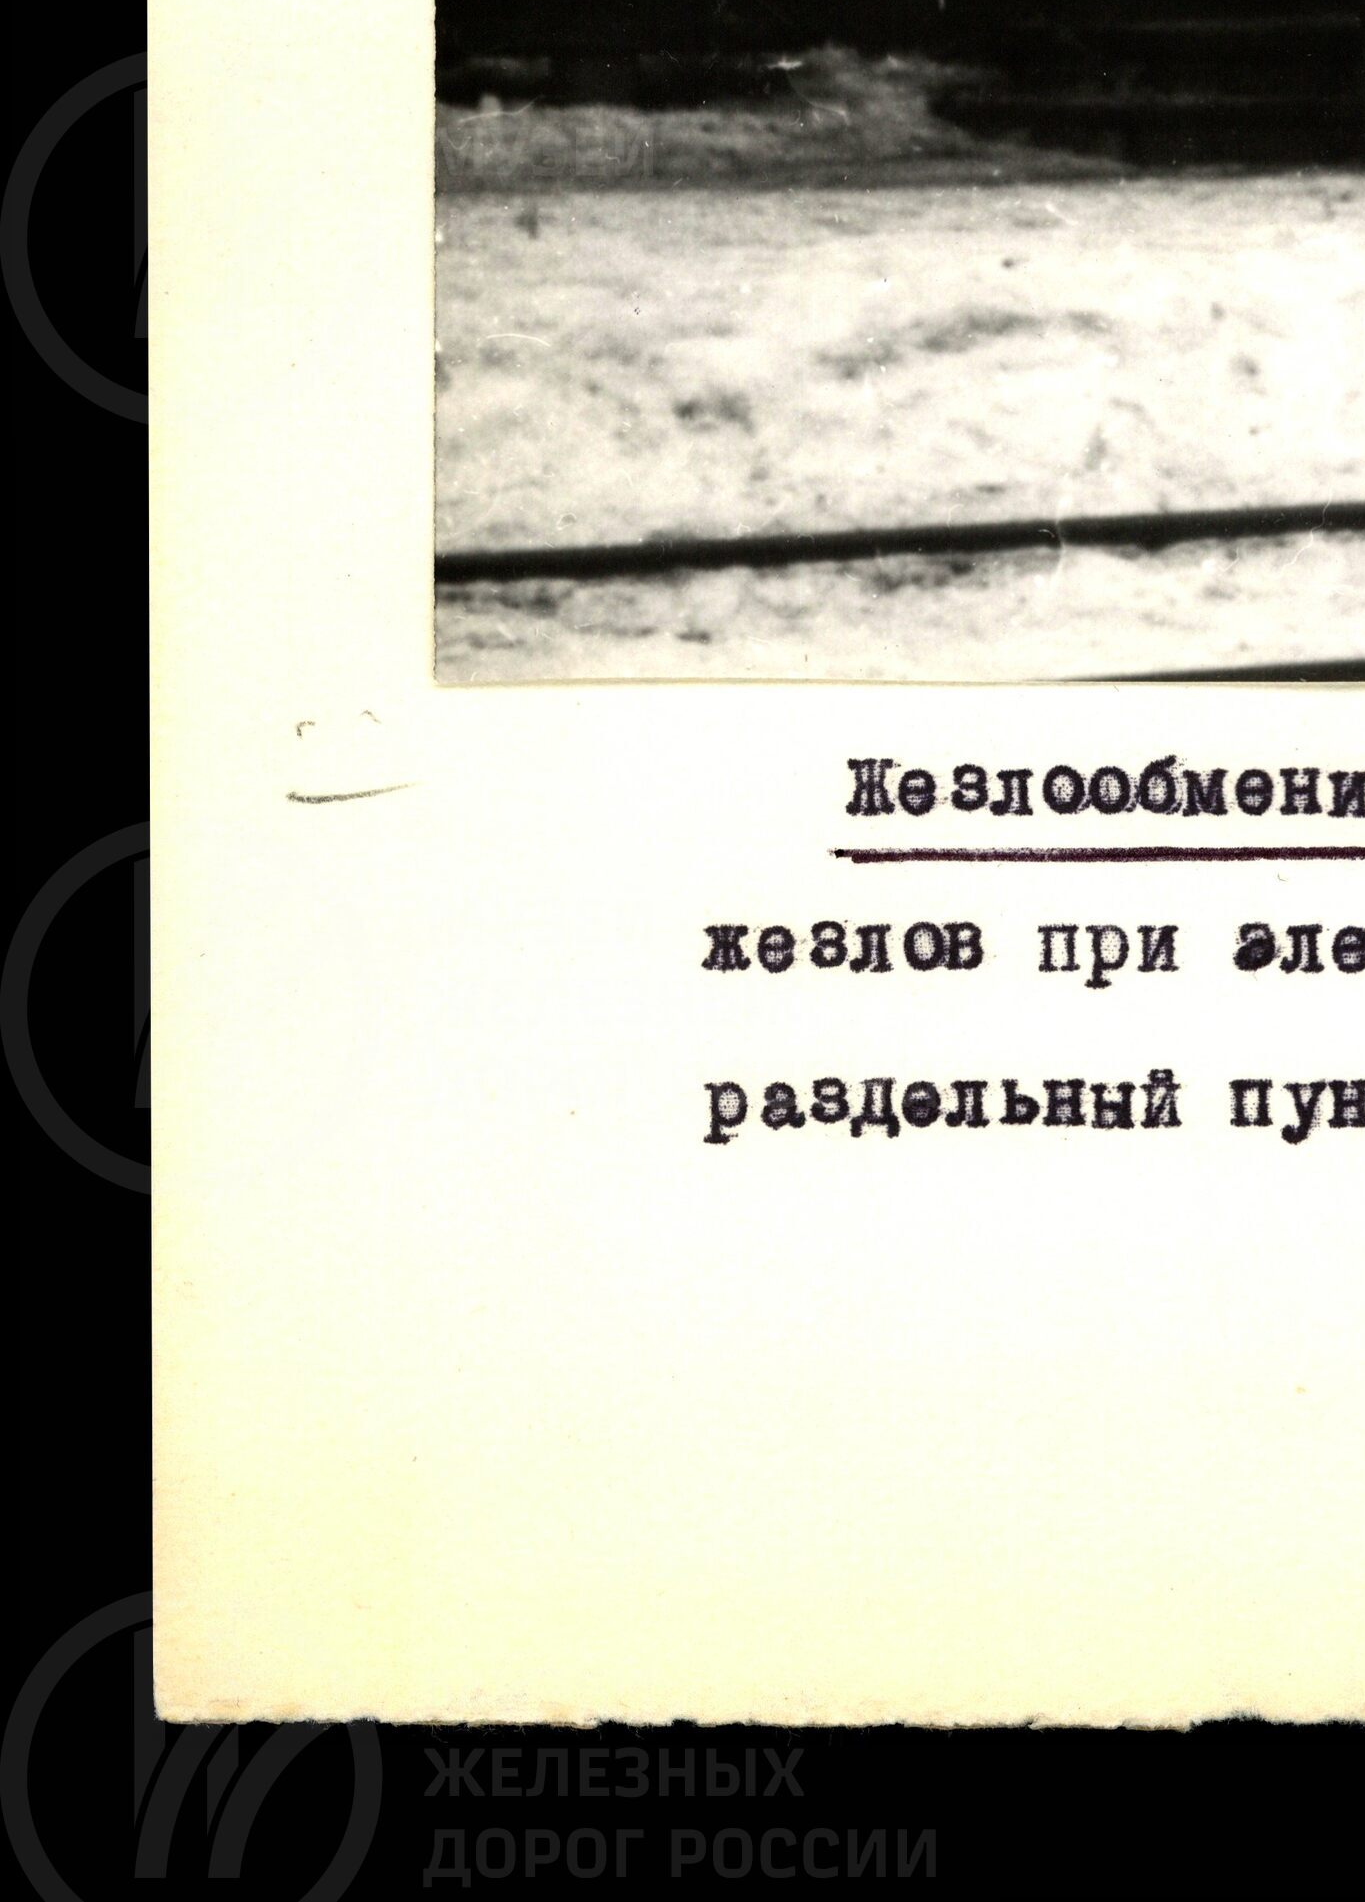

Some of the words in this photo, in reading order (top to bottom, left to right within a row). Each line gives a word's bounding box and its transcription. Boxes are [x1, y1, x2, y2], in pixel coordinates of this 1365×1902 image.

[701, 919, 985, 974] жезлов
[1037, 923, 1180, 989] при
[703, 1068, 1183, 1145] раздельный
